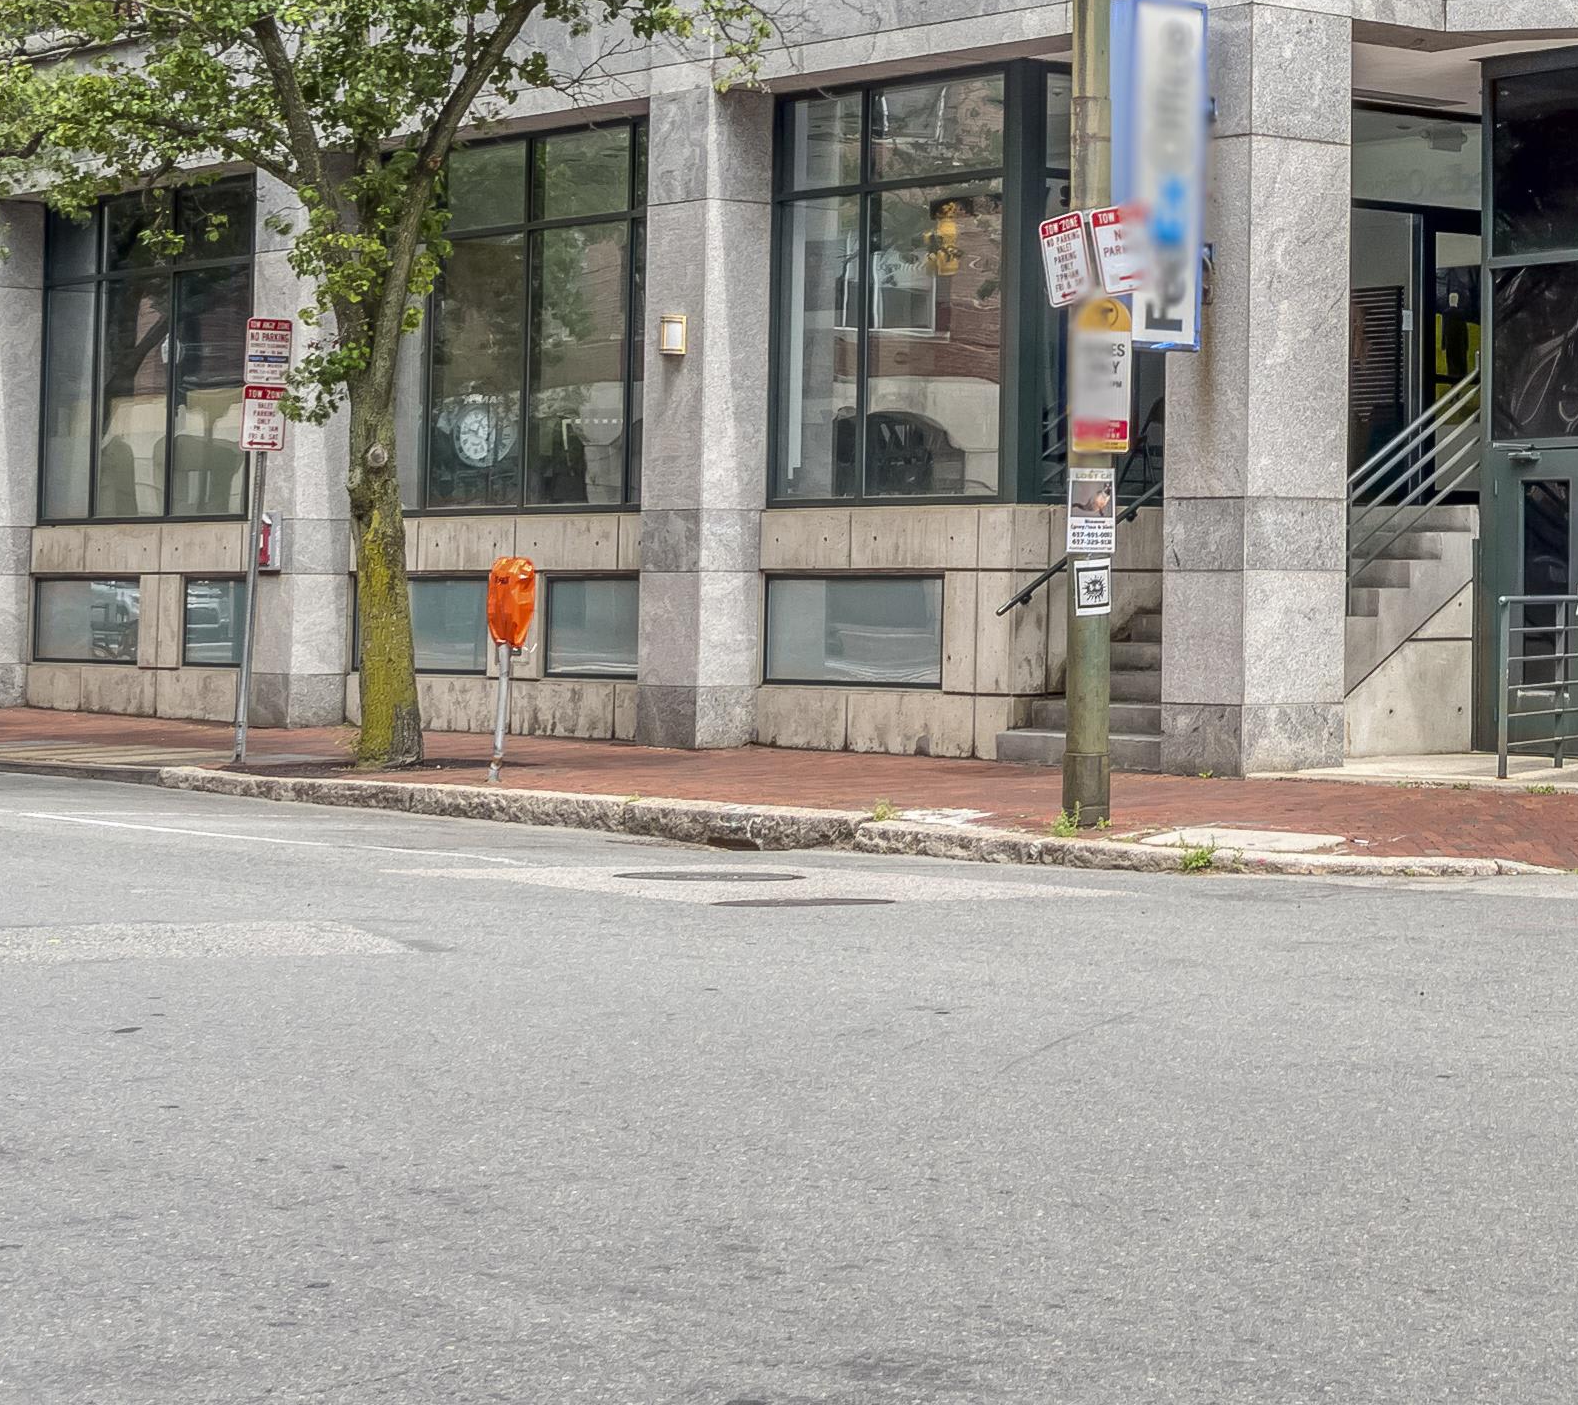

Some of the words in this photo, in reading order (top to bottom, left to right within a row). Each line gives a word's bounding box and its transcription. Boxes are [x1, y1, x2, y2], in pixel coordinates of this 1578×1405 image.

[1060, 216, 1079, 231] ZONE
[1098, 211, 1115, 225] TOW
[1057, 231, 1080, 246] PARKING
[1054, 252, 1077, 264] PARKING
[248, 389, 263, 398] TOW
